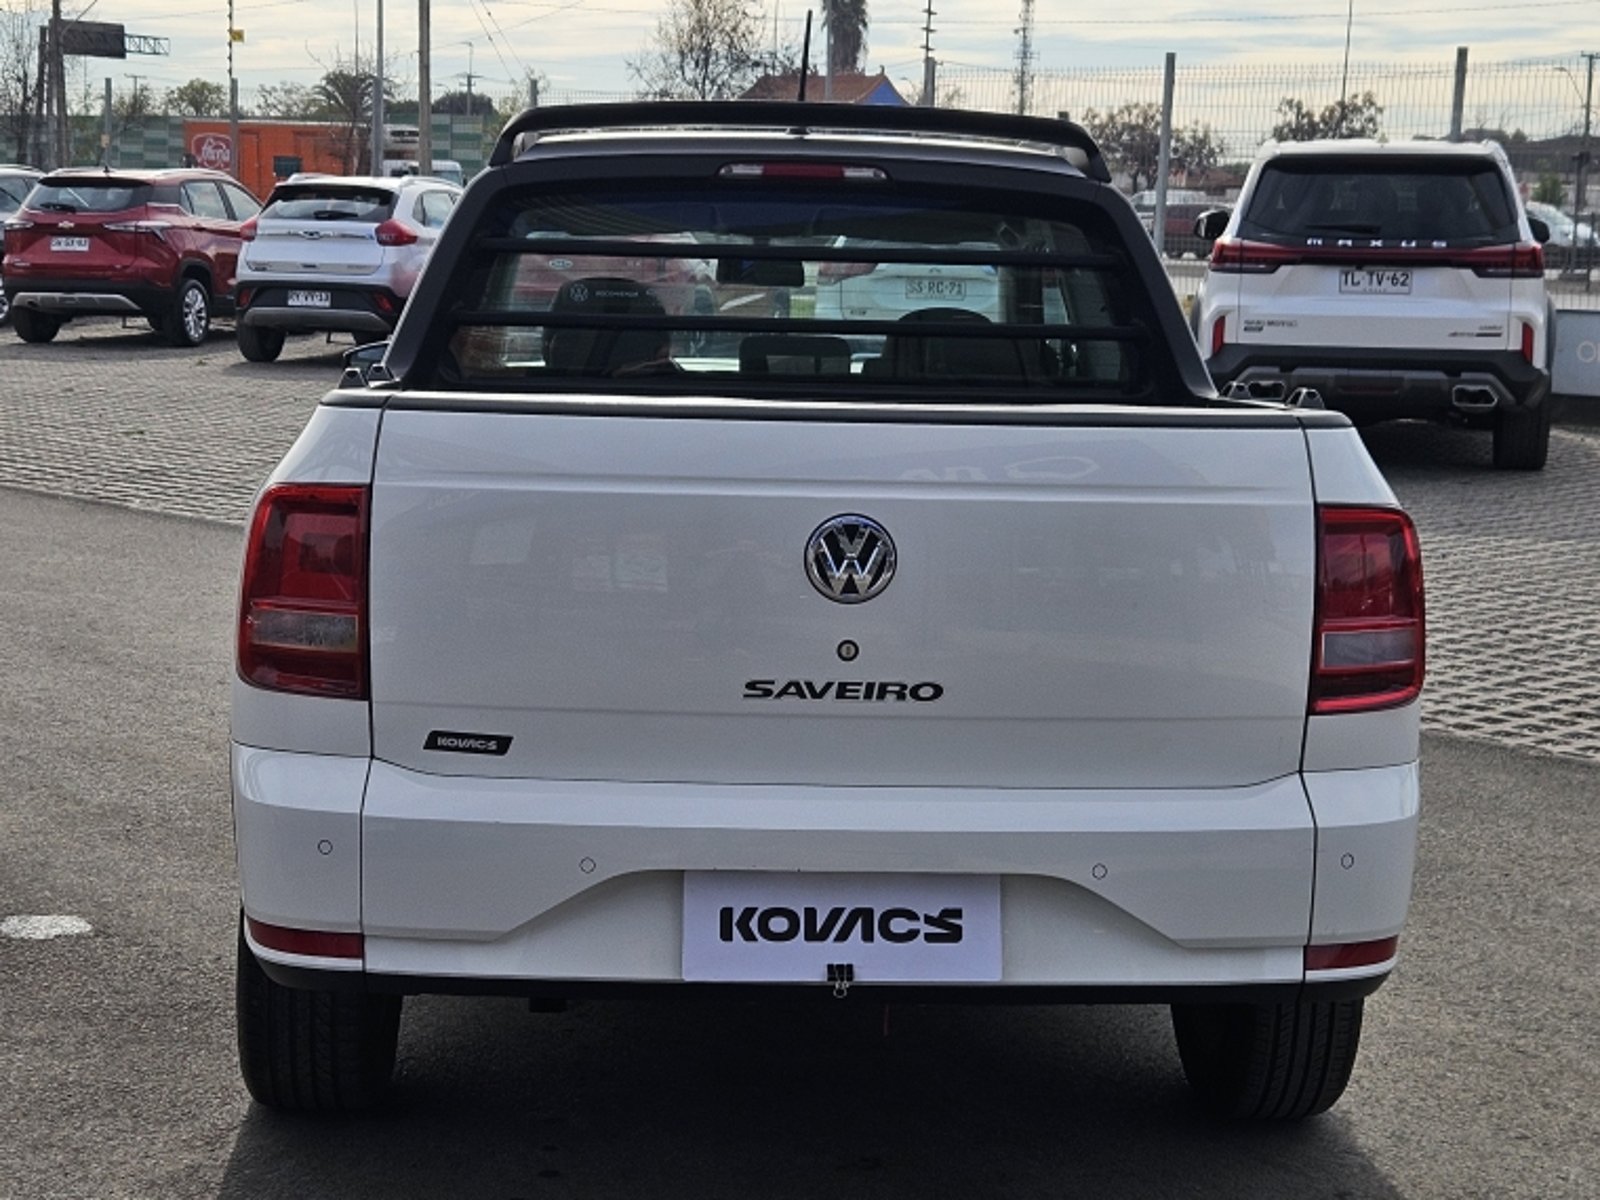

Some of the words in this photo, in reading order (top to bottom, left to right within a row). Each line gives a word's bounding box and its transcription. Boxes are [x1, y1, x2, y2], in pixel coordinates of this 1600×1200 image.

[743, 679, 944, 702] SAVEIRO
[436, 736, 498, 751] KOVACS
[718, 906, 964, 944] KOVACS
